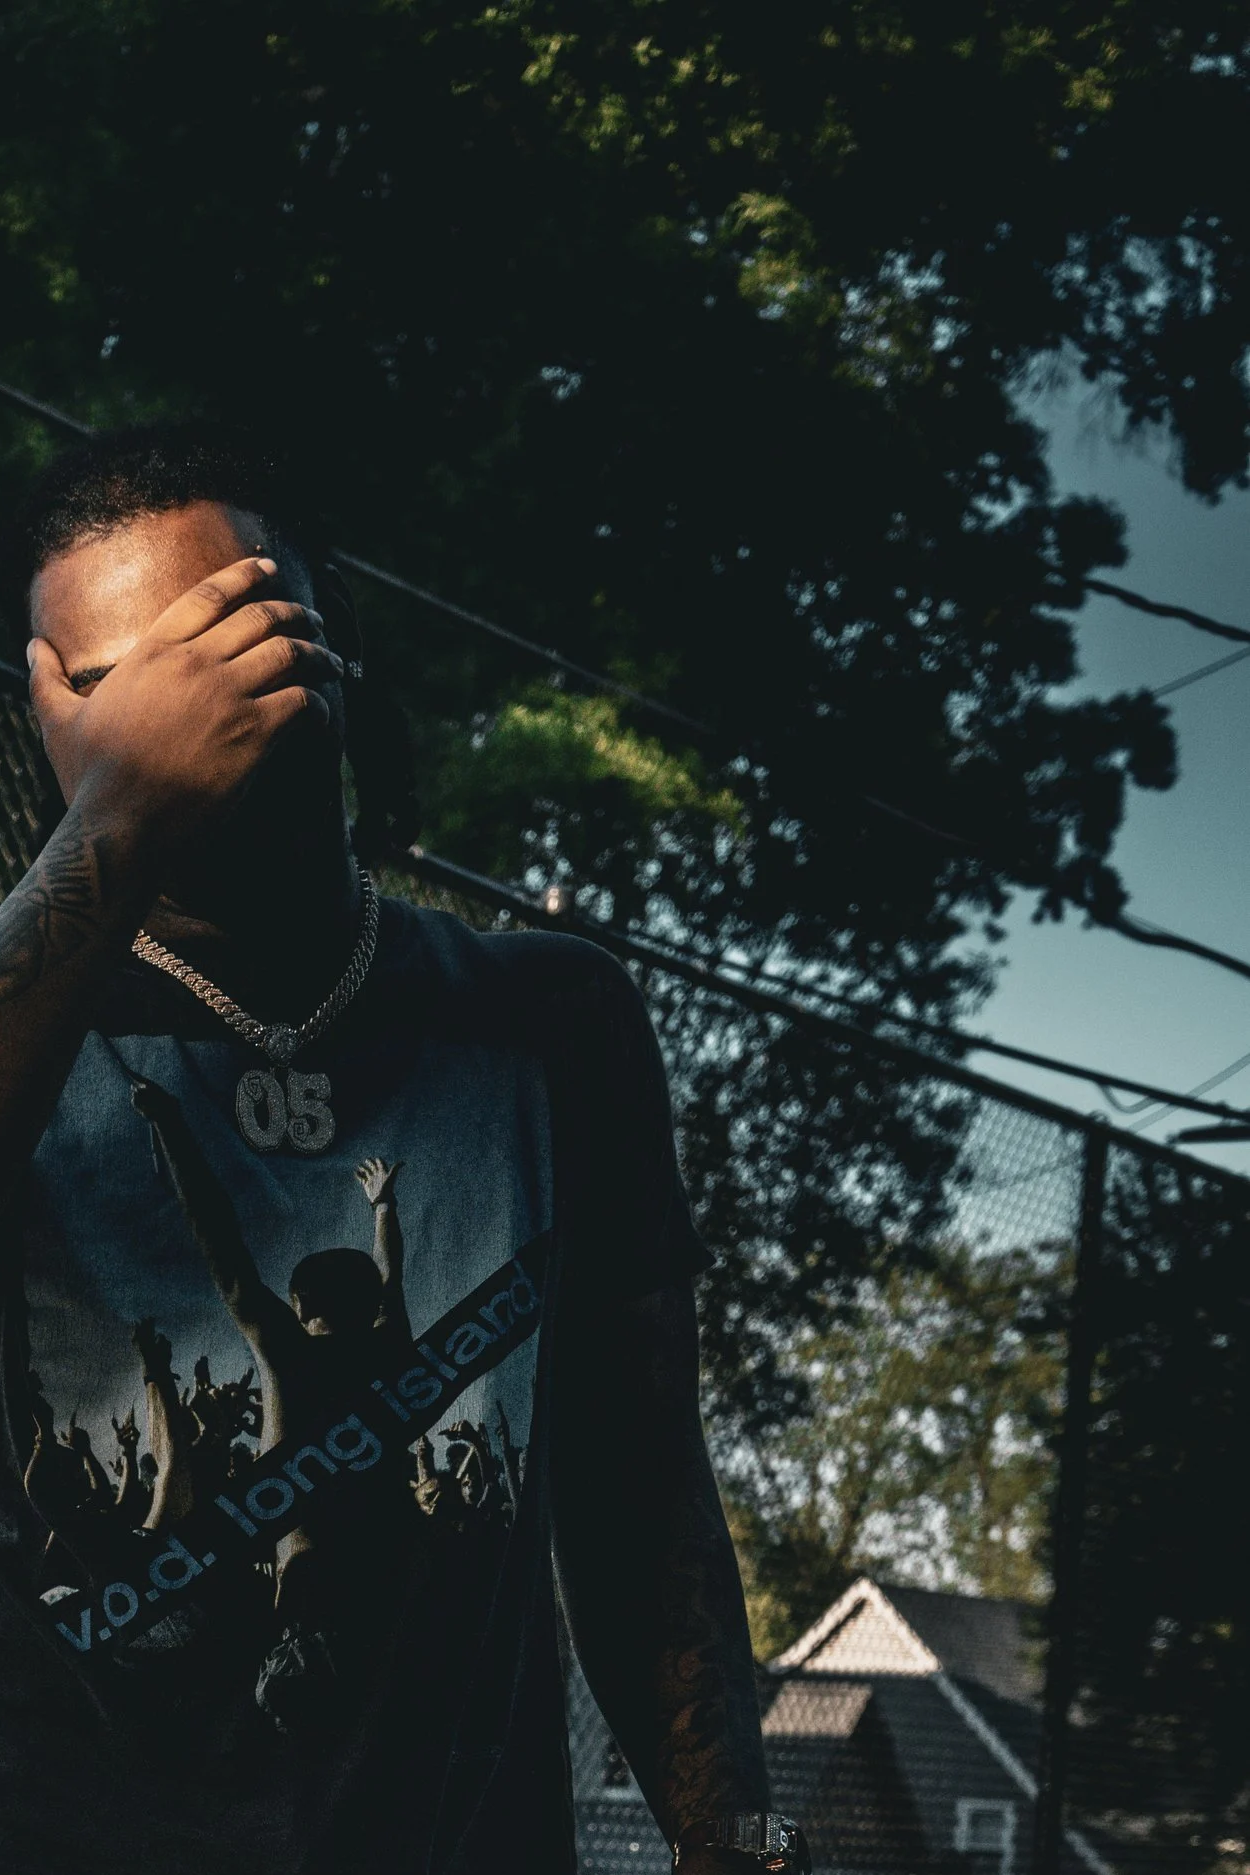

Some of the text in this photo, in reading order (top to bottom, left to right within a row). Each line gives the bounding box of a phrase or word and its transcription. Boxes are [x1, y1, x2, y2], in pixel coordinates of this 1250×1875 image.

[236, 1069, 336, 1153] 05
[56, 1259, 541, 1654] v.o.d. long island
